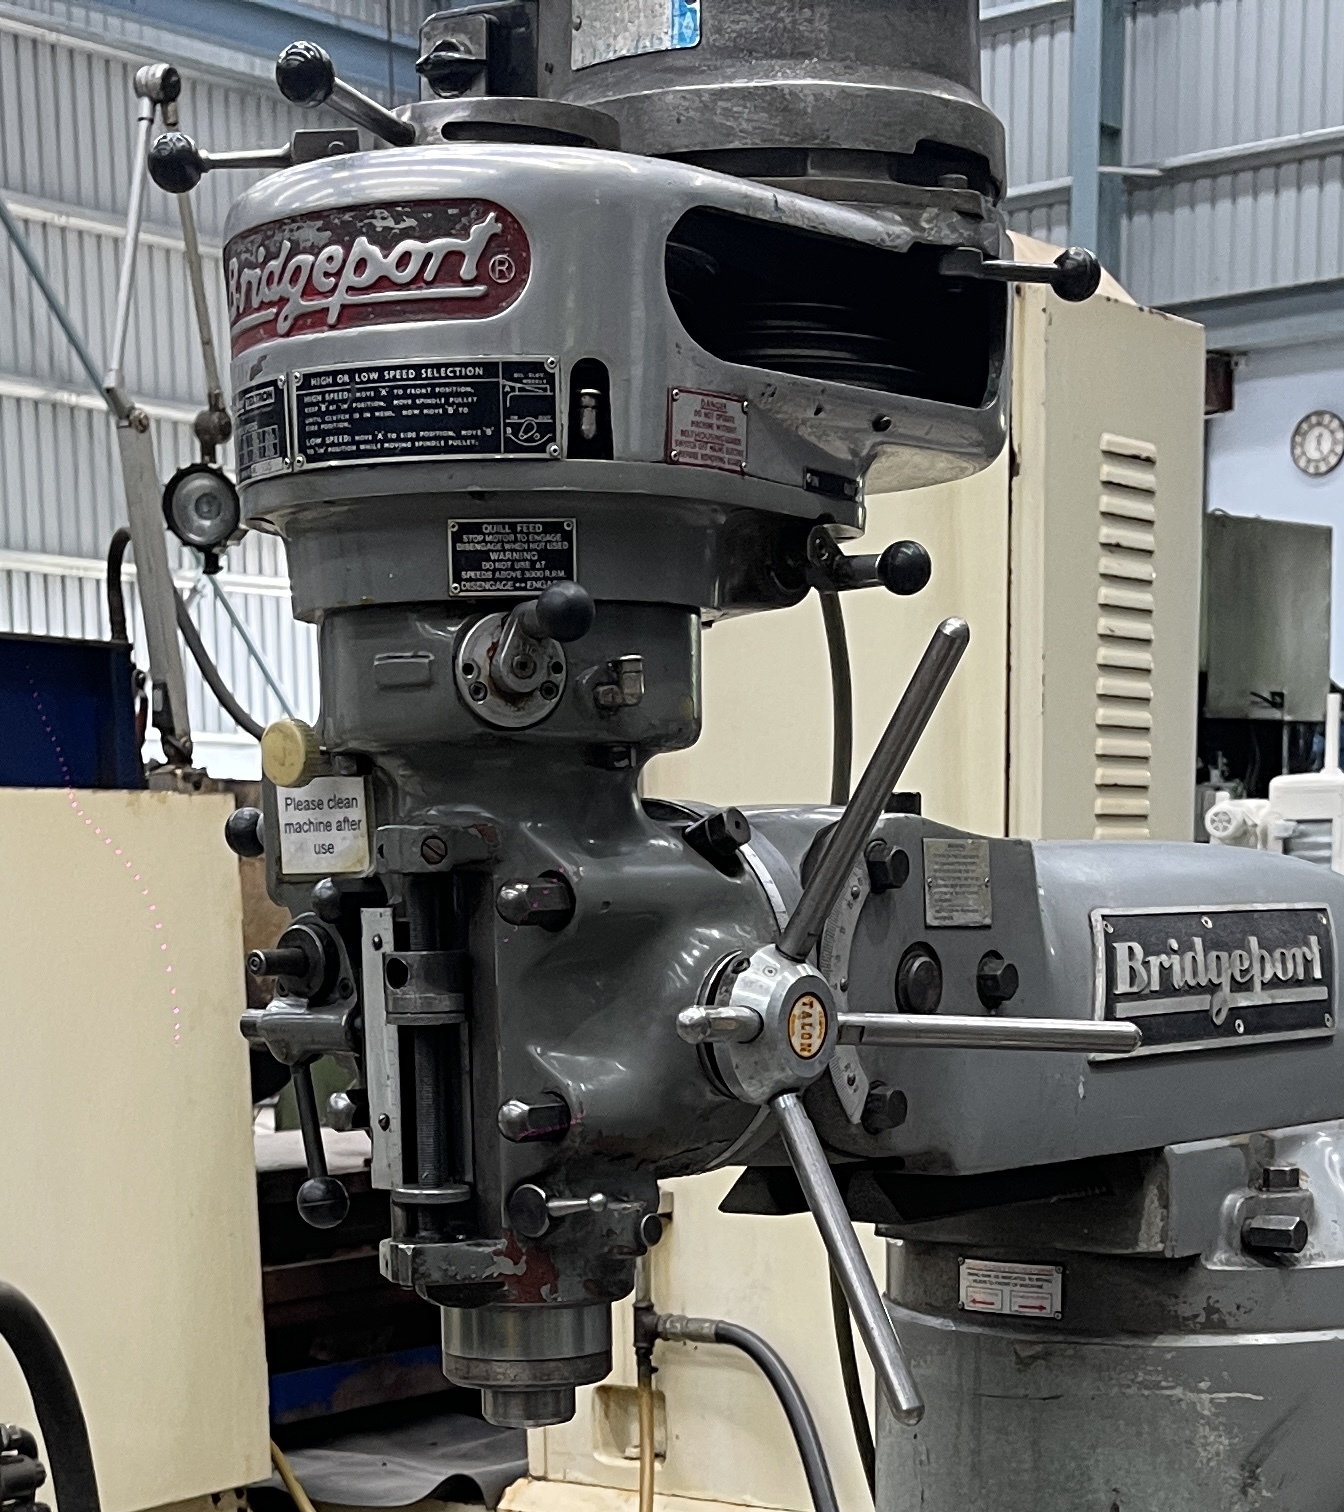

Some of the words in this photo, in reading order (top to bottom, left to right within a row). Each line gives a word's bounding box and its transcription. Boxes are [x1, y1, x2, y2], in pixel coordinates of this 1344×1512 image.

[228, 211, 502, 335] Bridgeport
[311, 376, 332, 386] HIGH
[337, 375, 350, 383] OR
[355, 372, 378, 382] LOW
[384, 369, 416, 379] SPEED
[422, 367, 483, 378] SELECTION
[304, 394, 322, 403] HIGH
[306, 438, 322, 446] LOW
[482, 524, 511, 533] QUILL
[517, 524, 542, 532] FEED
[529, 542, 545, 550] NOT
[489, 551, 538, 560] WARNING
[482, 561, 494, 569] DO
[495, 561, 512, 569] NOT
[461, 571, 492, 579] SPEEDS
[495, 570, 522, 578] ABOVE
[524, 570, 544, 578] 3000
[461, 581, 514, 590] DISENGAGE
[527, 580, 557, 589] ENGA
[284, 797, 324, 812] Please
[327, 794, 358, 809] clean
[284, 818, 332, 834] machine
[336, 816, 362, 832] after
[314, 843, 334, 855] use
[1112, 935, 1322, 1026] Bridgeport
[800, 1000, 813, 1053] TALON
